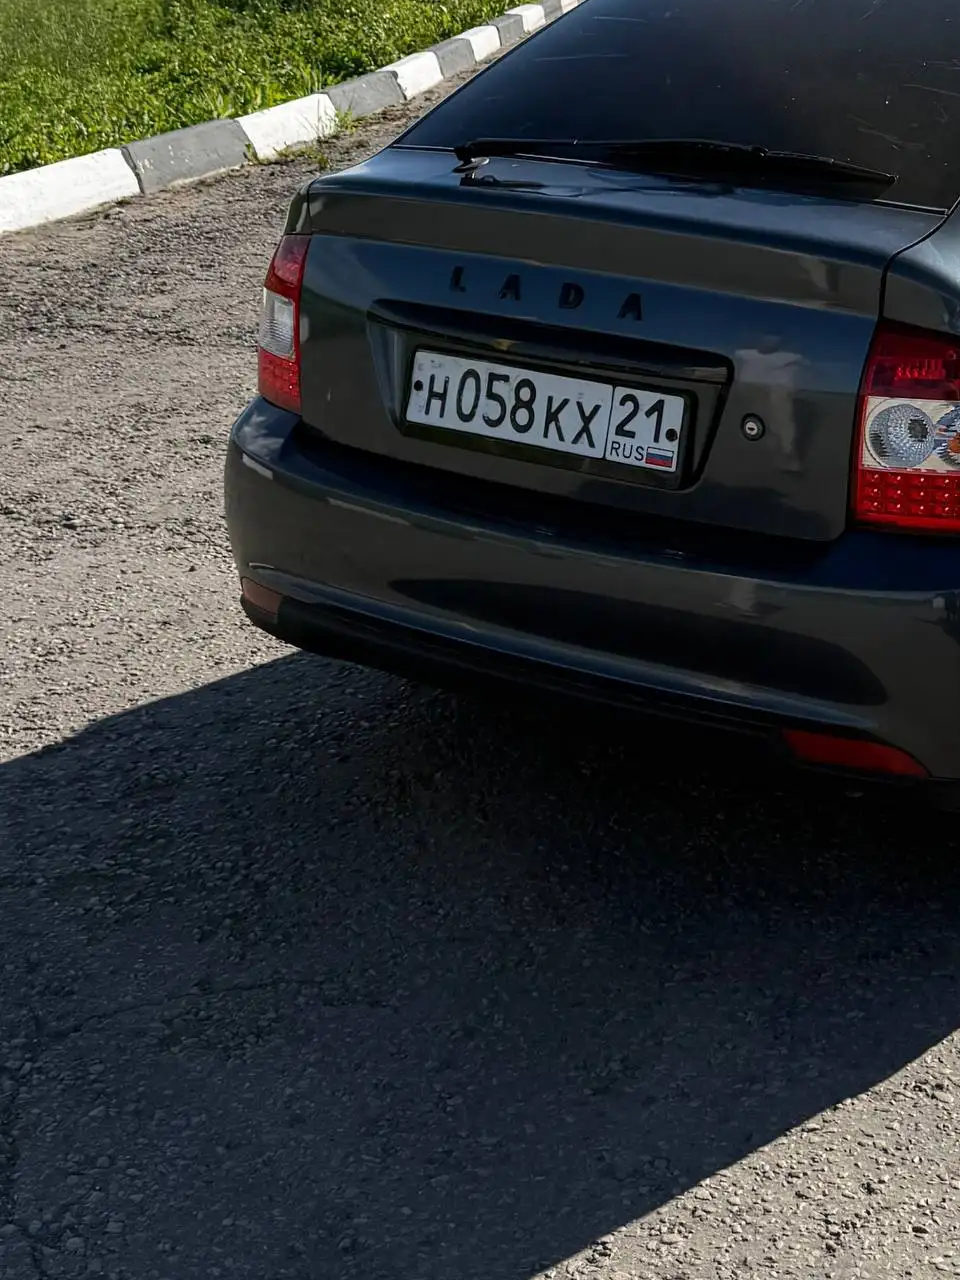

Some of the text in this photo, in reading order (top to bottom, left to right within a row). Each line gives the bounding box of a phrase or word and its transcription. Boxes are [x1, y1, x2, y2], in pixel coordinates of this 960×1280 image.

[450, 266, 643, 321] LADA
[614, 393, 666, 444] 21
[609, 441, 645, 463] RUS
